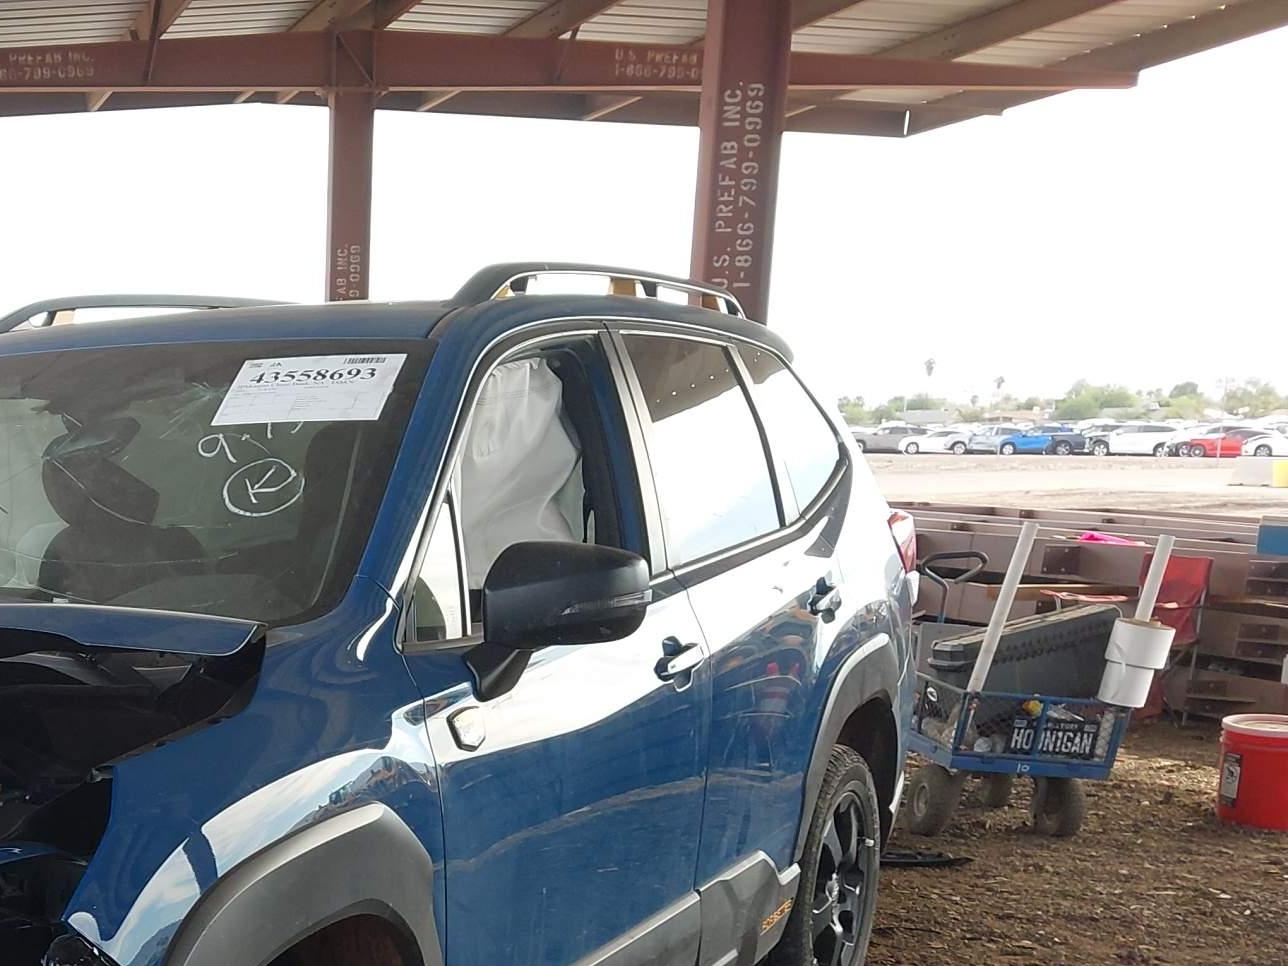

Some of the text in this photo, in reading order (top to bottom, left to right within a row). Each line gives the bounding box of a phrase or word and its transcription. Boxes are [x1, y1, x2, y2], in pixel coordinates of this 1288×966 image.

[723, 80, 744, 128] INC.
[715, 140, 739, 233] PREFAB
[249, 367, 377, 385] 43558693
